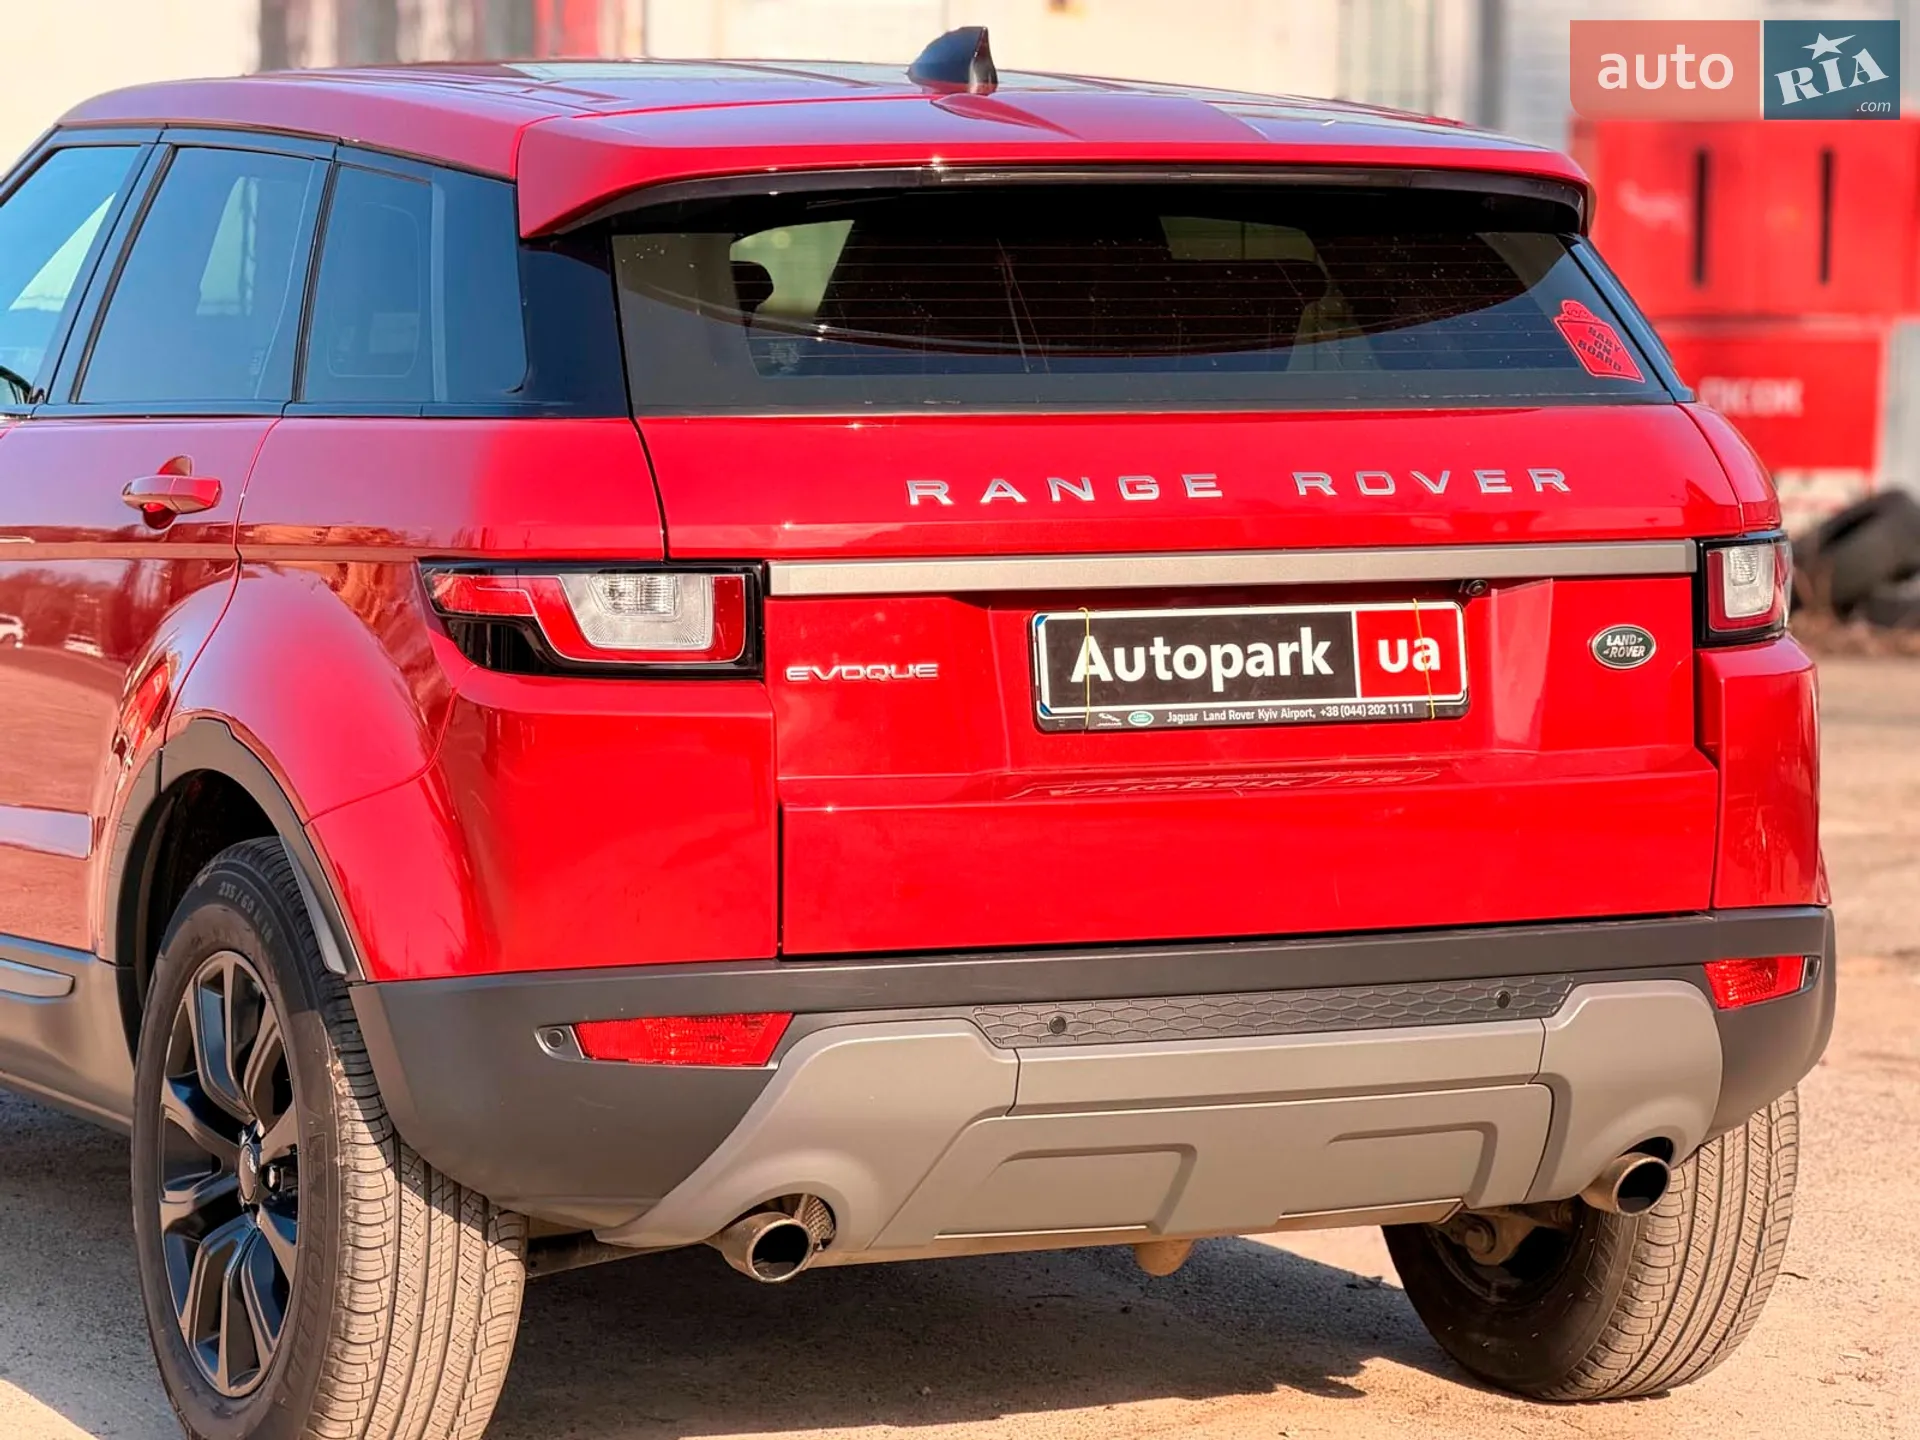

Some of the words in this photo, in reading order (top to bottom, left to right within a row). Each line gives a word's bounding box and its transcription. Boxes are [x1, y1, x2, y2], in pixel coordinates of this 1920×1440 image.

[1588, 326, 1620, 352] BABY
[1594, 340, 1611, 355] ON
[1578, 339, 1621, 371] BOARD
[906, 473, 1223, 505] RANGE
[1292, 468, 1571, 497] ROVER
[1606, 633, 1636, 646] LAND
[1071, 627, 1334, 692] Autopark
[1378, 636, 1441, 674] ua
[1609, 645, 1646, 658] ROVER
[785, 663, 939, 682] EVOQUE
[1166, 711, 1199, 725] Jaguar
[1203, 710, 1227, 721] Land
[1228, 709, 1254, 721] Rover
[1257, 708, 1278, 721] Kyiv
[1280, 706, 1316, 720] Airport,
[1320, 705, 1339, 717] +38
[1340, 703, 1367, 718] (044)
[1367, 704, 1387, 716] 202
